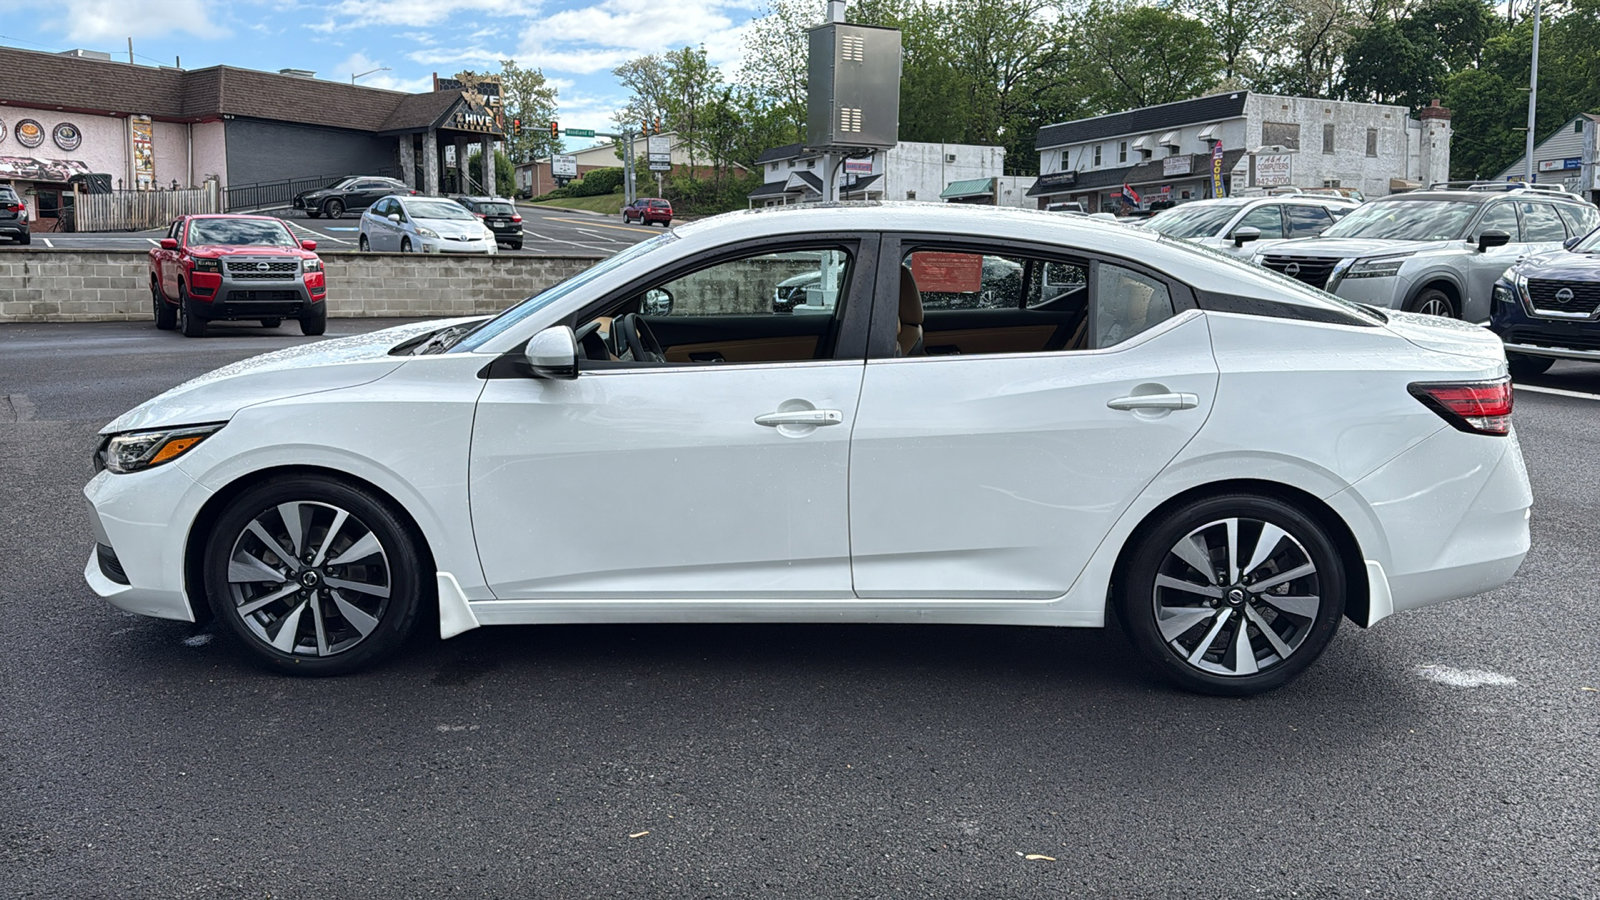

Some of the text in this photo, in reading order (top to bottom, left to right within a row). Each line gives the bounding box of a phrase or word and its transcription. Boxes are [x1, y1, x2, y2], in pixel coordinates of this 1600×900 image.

[465, 113, 493, 127] HIVE
[1257, 162, 1290, 171] COMPUTERS
[1256, 176, 1290, 186] 942-9700
